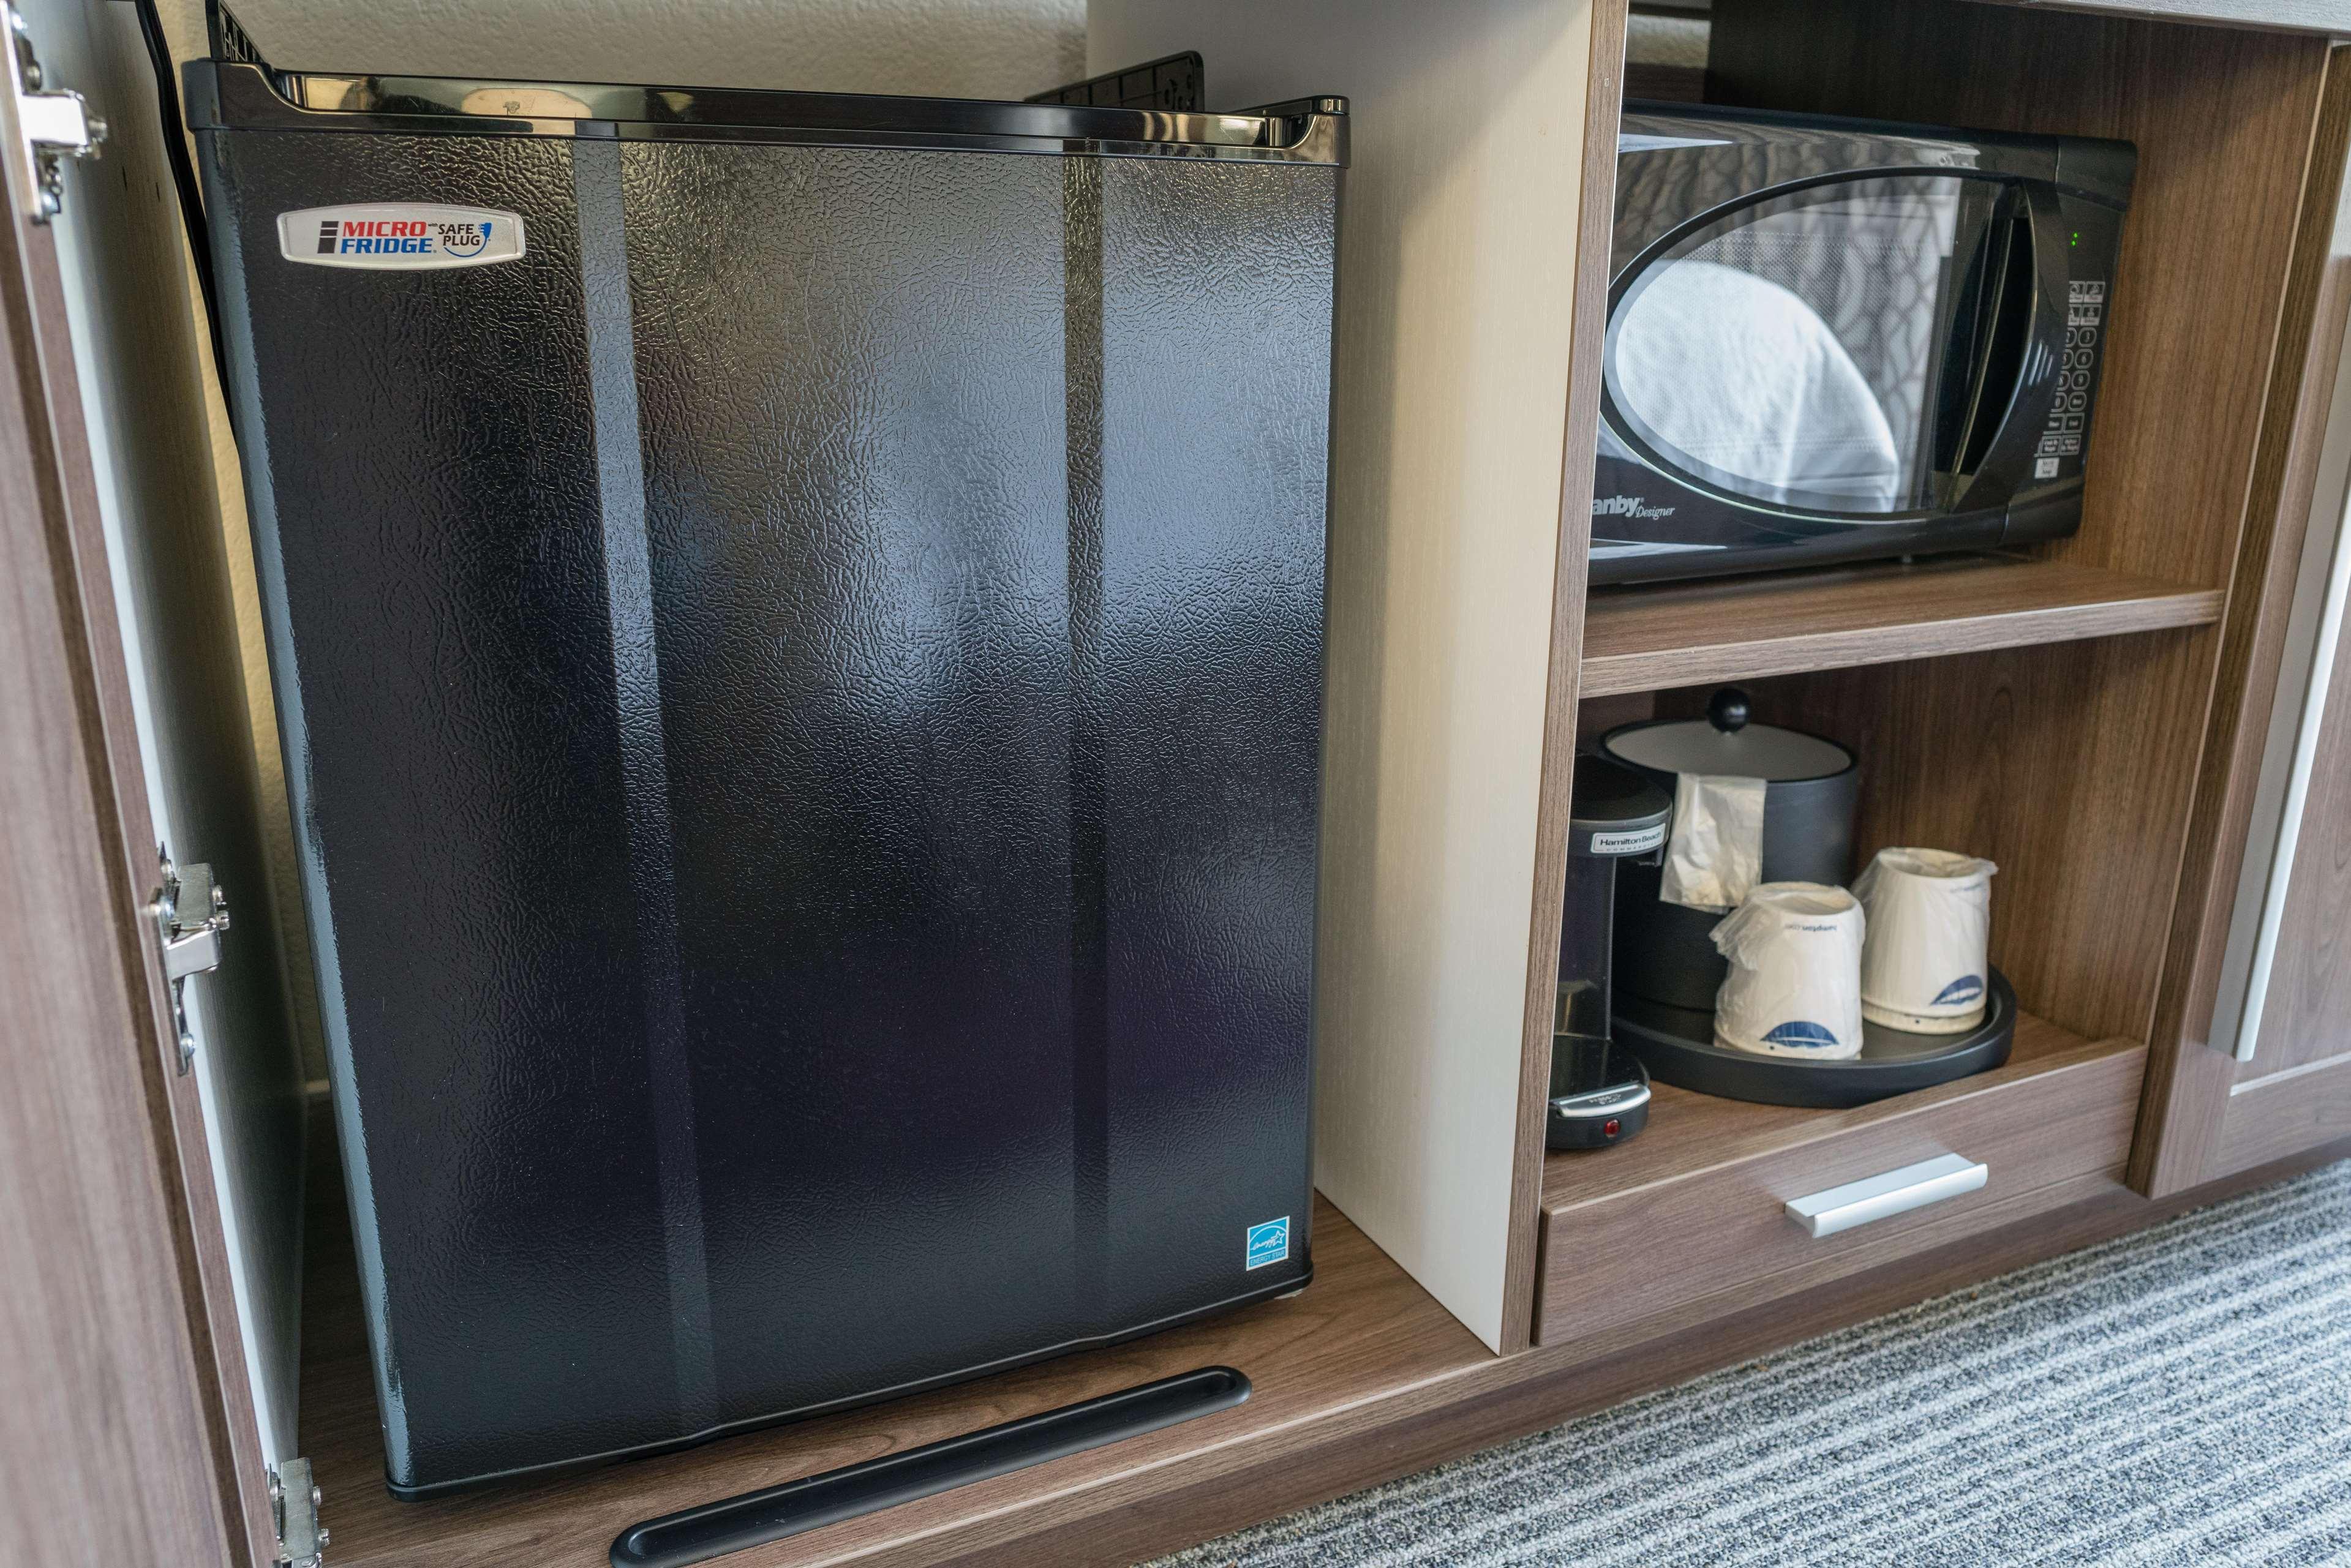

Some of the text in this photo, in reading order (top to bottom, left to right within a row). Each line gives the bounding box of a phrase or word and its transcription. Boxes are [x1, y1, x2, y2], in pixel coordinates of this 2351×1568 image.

[343, 221, 427, 237] MICRO
[438, 224, 474, 234] SAFE
[340, 238, 433, 253] FRIDGE
[443, 235, 480, 246] PLUG
[1592, 495, 1675, 520] anby Designer
[1600, 831, 1661, 846] Hamilton Beach
[1250, 1250, 1285, 1266] ENERGY STAR
